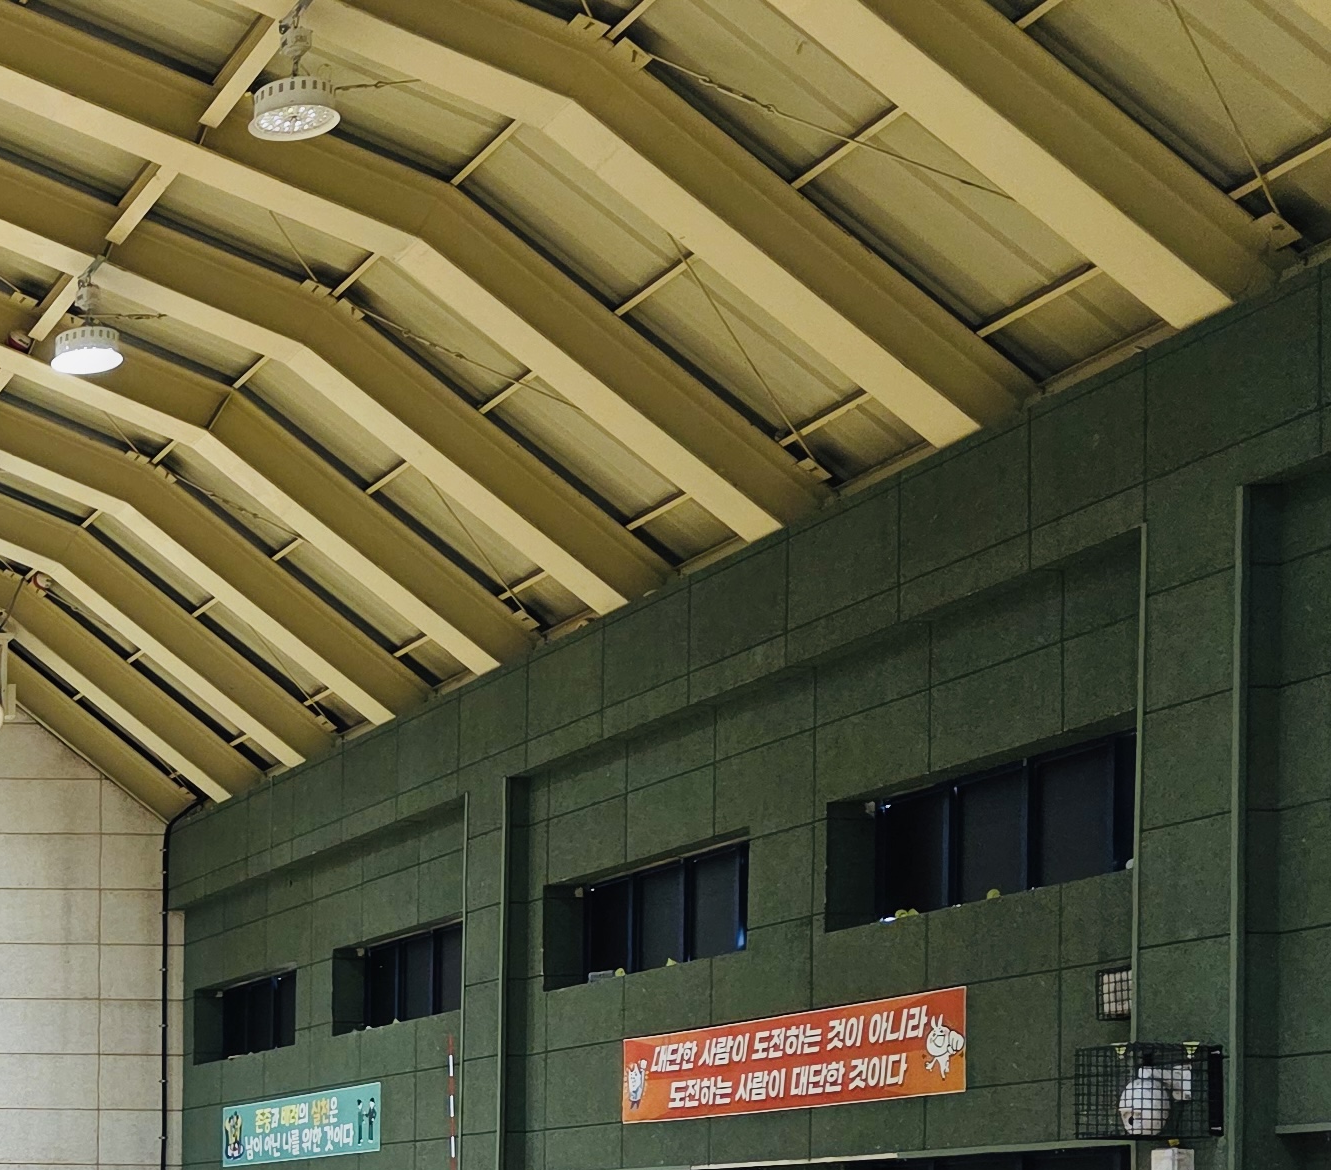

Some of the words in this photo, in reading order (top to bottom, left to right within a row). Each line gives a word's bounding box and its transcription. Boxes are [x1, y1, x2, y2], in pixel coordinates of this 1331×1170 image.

[651, 1041, 697, 1073] 대단한
[698, 1033, 750, 1067] 사람이
[752, 1024, 822, 1060] 도전하는
[827, 1014, 864, 1050] 것이
[868, 1005, 928, 1044] 아니라
[668, 1076, 732, 1108] 도전하는
[735, 1067, 786, 1102] 사람이
[790, 1060, 845, 1095] 대단한
[848, 1053, 907, 1088] 것이다
[255, 1107, 280, 1134] 존중과
[281, 1102, 309, 1127] 배려의
[311, 1096, 338, 1125] 실천은
[244, 1134, 262, 1160] 남이
[264, 1132, 280, 1157] 아닌
[282, 1129, 300, 1156] 나를
[302, 1125, 322, 1153] 위한
[324, 1122, 354, 1151] 것이다
